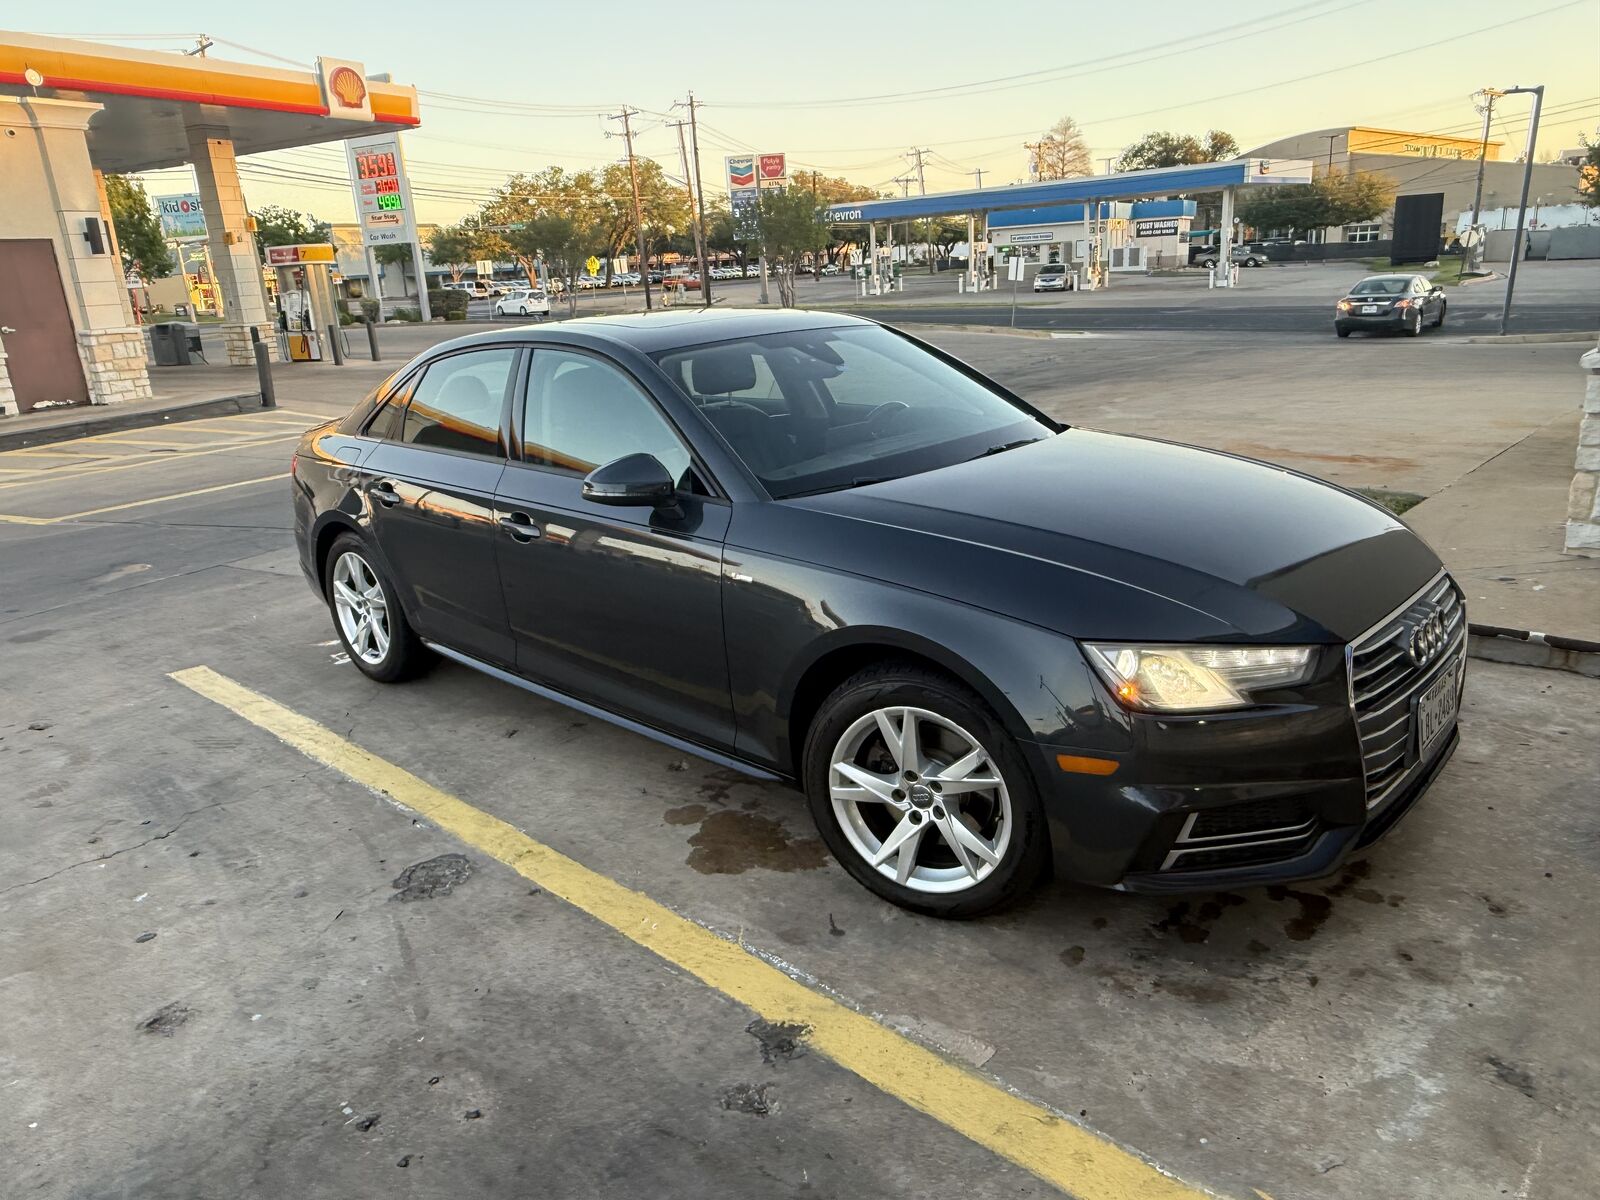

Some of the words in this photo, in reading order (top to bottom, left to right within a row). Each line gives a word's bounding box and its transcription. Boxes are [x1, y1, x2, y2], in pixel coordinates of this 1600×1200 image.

[824, 209, 862, 222] Chevron
[1139, 222, 1153, 230] JUST
[1153, 220, 1178, 229] WASHED
[369, 233, 379, 241] Car
[381, 231, 396, 240] Wash
